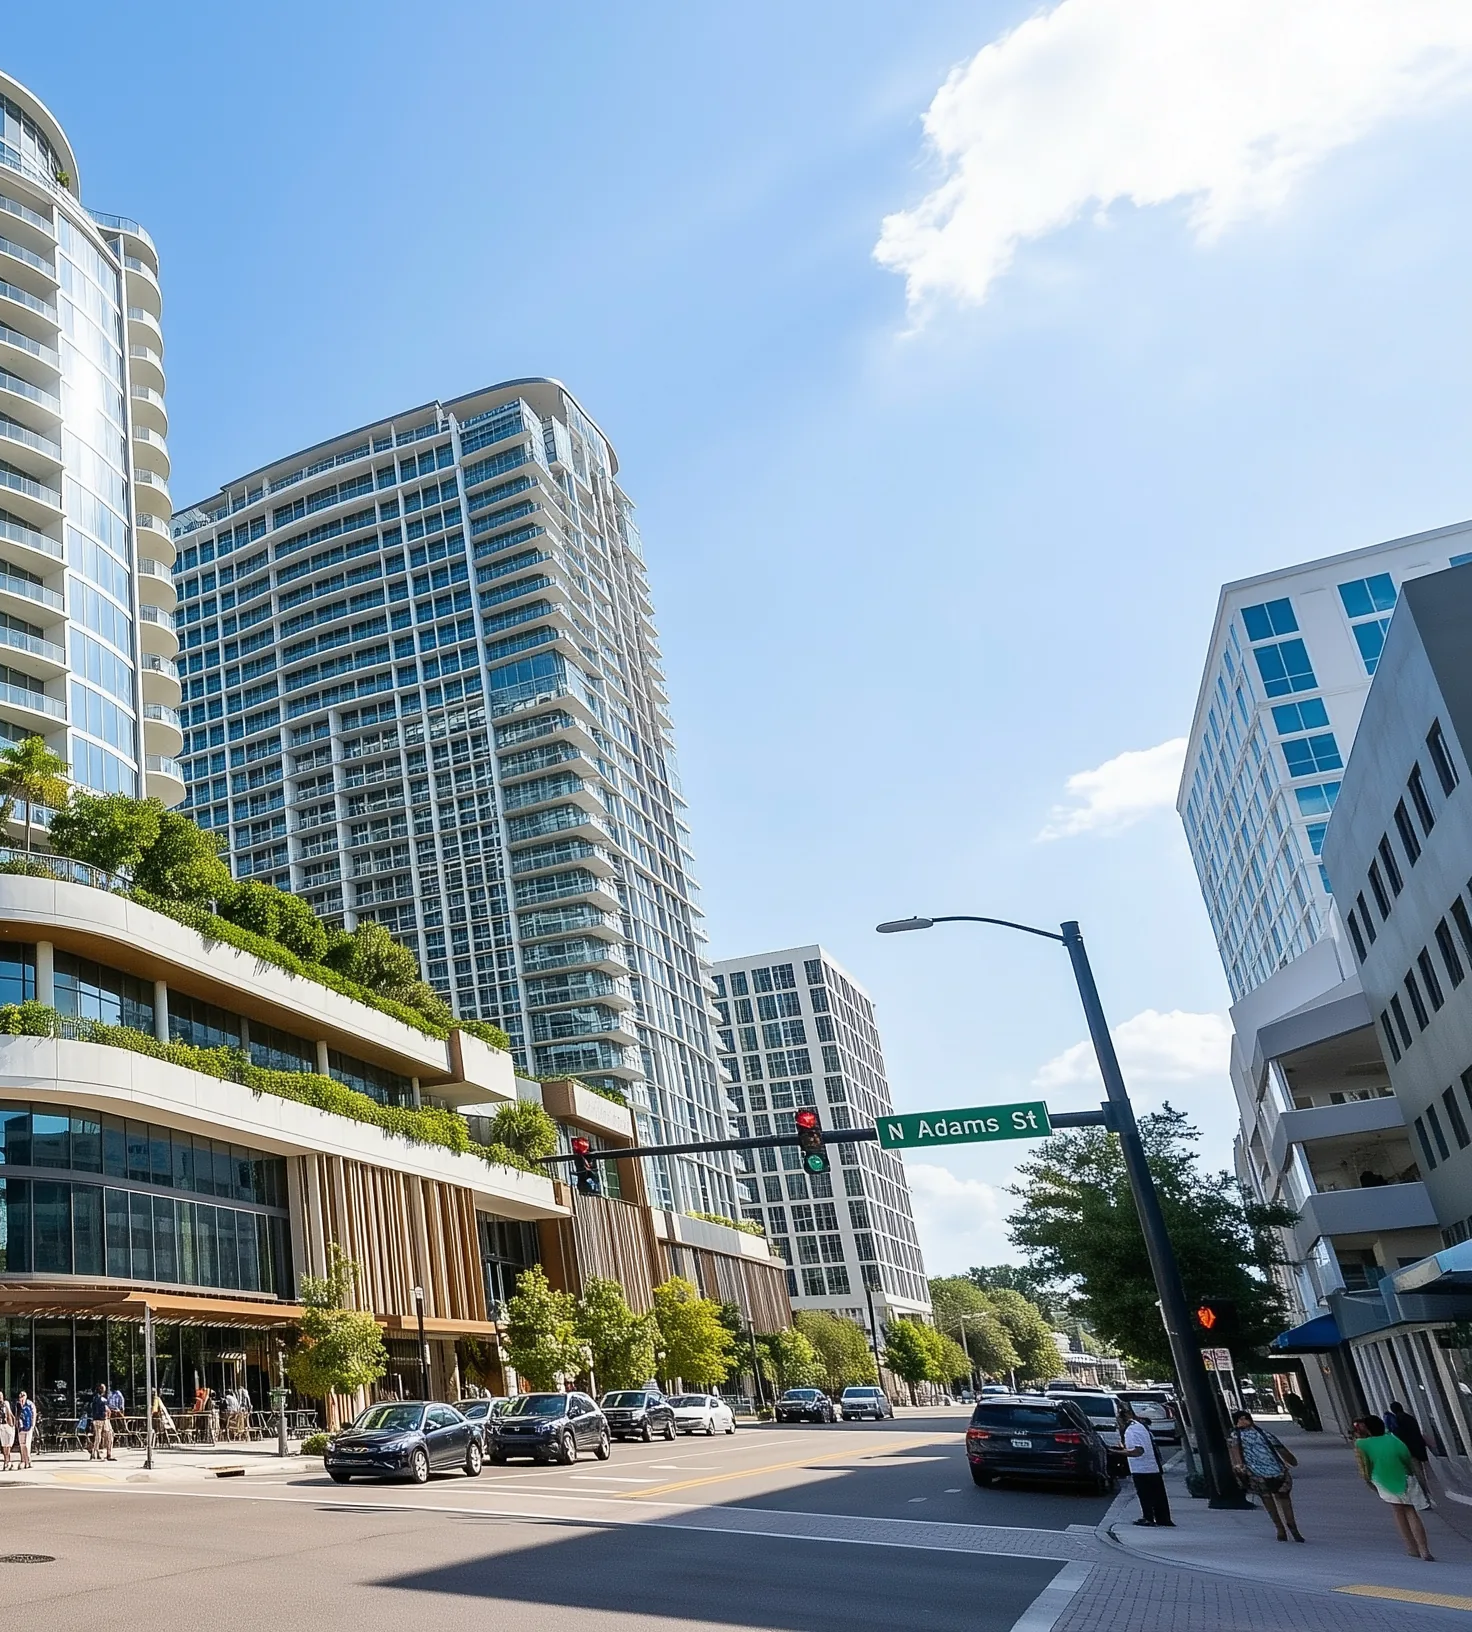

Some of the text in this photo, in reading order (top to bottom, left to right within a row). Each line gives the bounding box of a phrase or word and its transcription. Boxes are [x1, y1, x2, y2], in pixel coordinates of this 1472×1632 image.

[888, 1110, 1038, 1141] N Adams St
